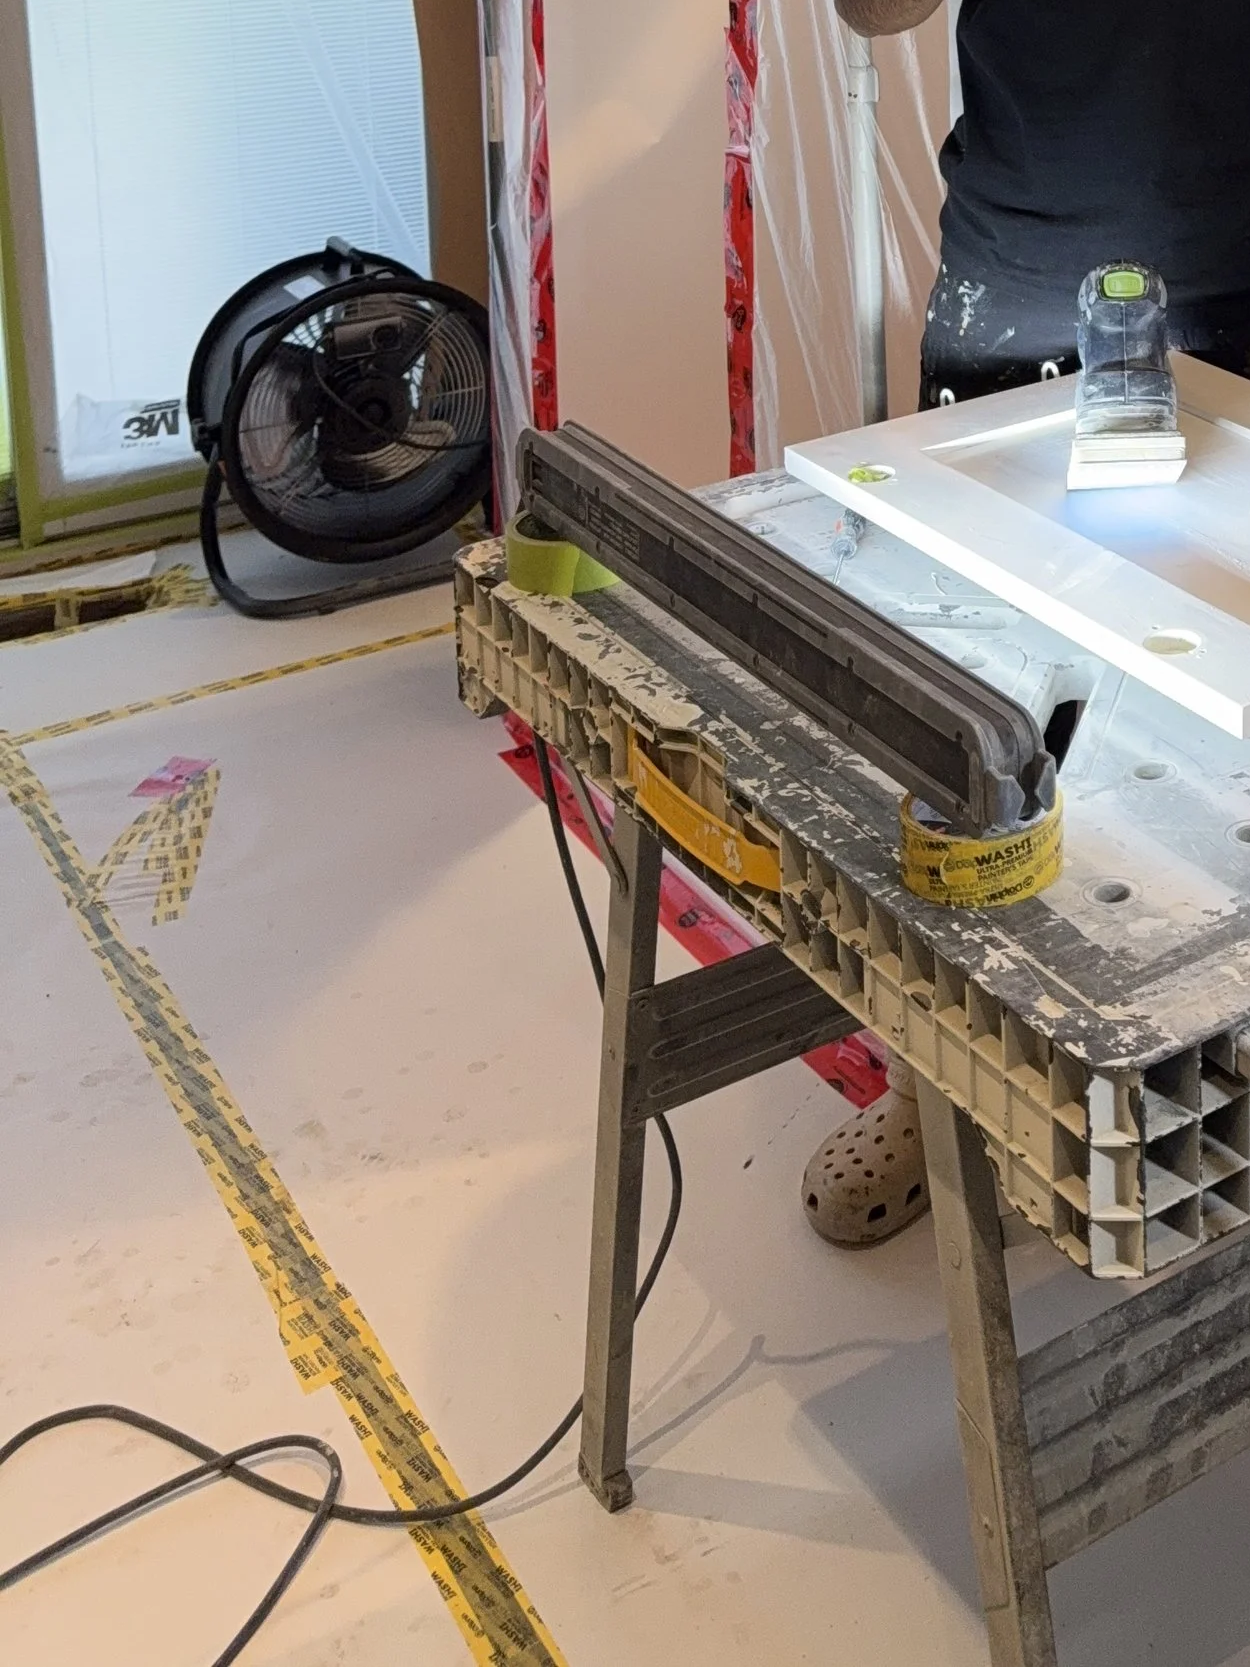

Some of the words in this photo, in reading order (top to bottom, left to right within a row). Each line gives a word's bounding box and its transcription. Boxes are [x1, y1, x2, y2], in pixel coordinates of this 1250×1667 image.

[974, 836, 1033, 867] WASHI
[310, 1253, 332, 1273] WASHI
[290, 1358, 311, 1381] WASHI
[331, 1377, 354, 1402] WASHI
[348, 1414, 373, 1438] WASHI
[405, 1409, 430, 1434] WASHI
[406, 1457, 432, 1483] WASHI
[408, 1527, 435, 1555] WASHI
[440, 1544, 467, 1573] WASHI
[431, 1570, 457, 1600] WASHI
[495, 1564, 523, 1593] WASHI
[499, 1621, 528, 1651] WASHI
